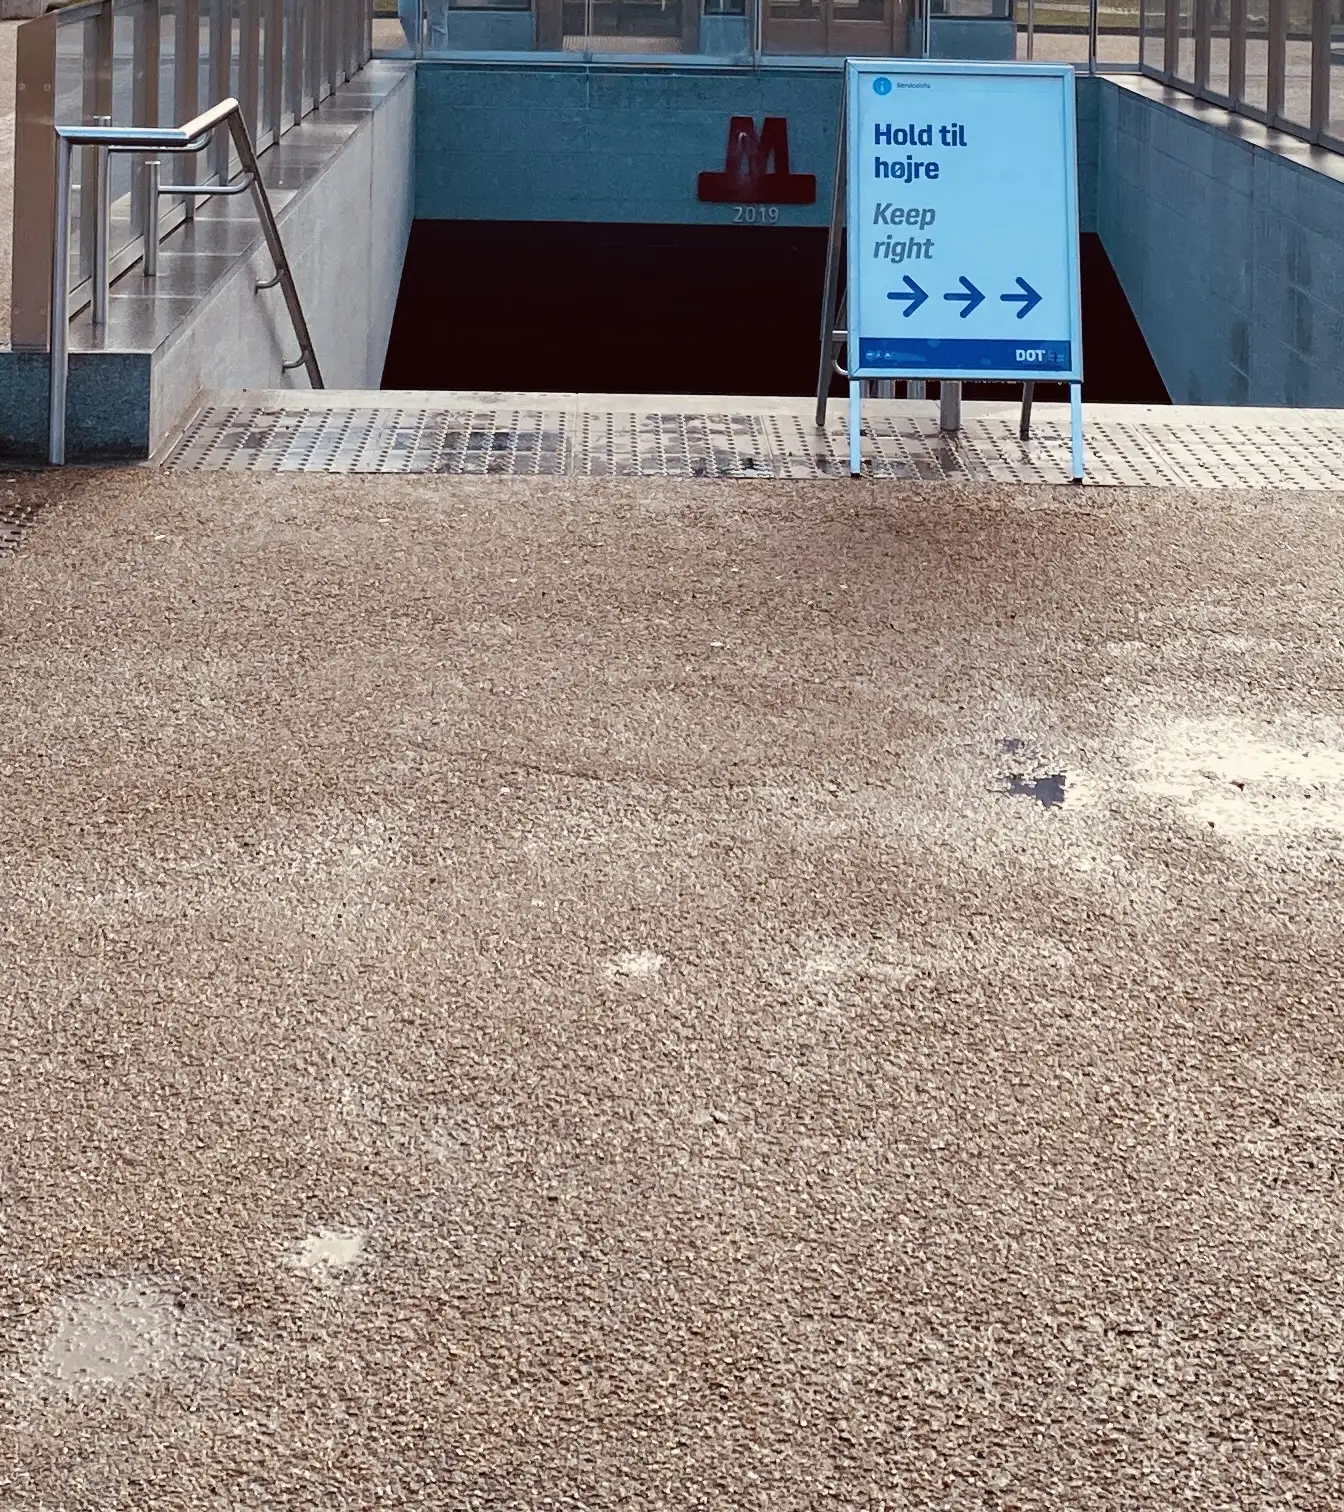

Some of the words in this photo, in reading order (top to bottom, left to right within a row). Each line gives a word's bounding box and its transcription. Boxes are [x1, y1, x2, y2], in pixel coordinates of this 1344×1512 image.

[874, 123, 933, 146] Hold
[938, 122, 968, 147] til
[874, 154, 940, 184] højre
[733, 206, 779, 224] 2019
[872, 202, 936, 231] Keep
[872, 234, 935, 264] right
[1015, 349, 1046, 362] DOT
